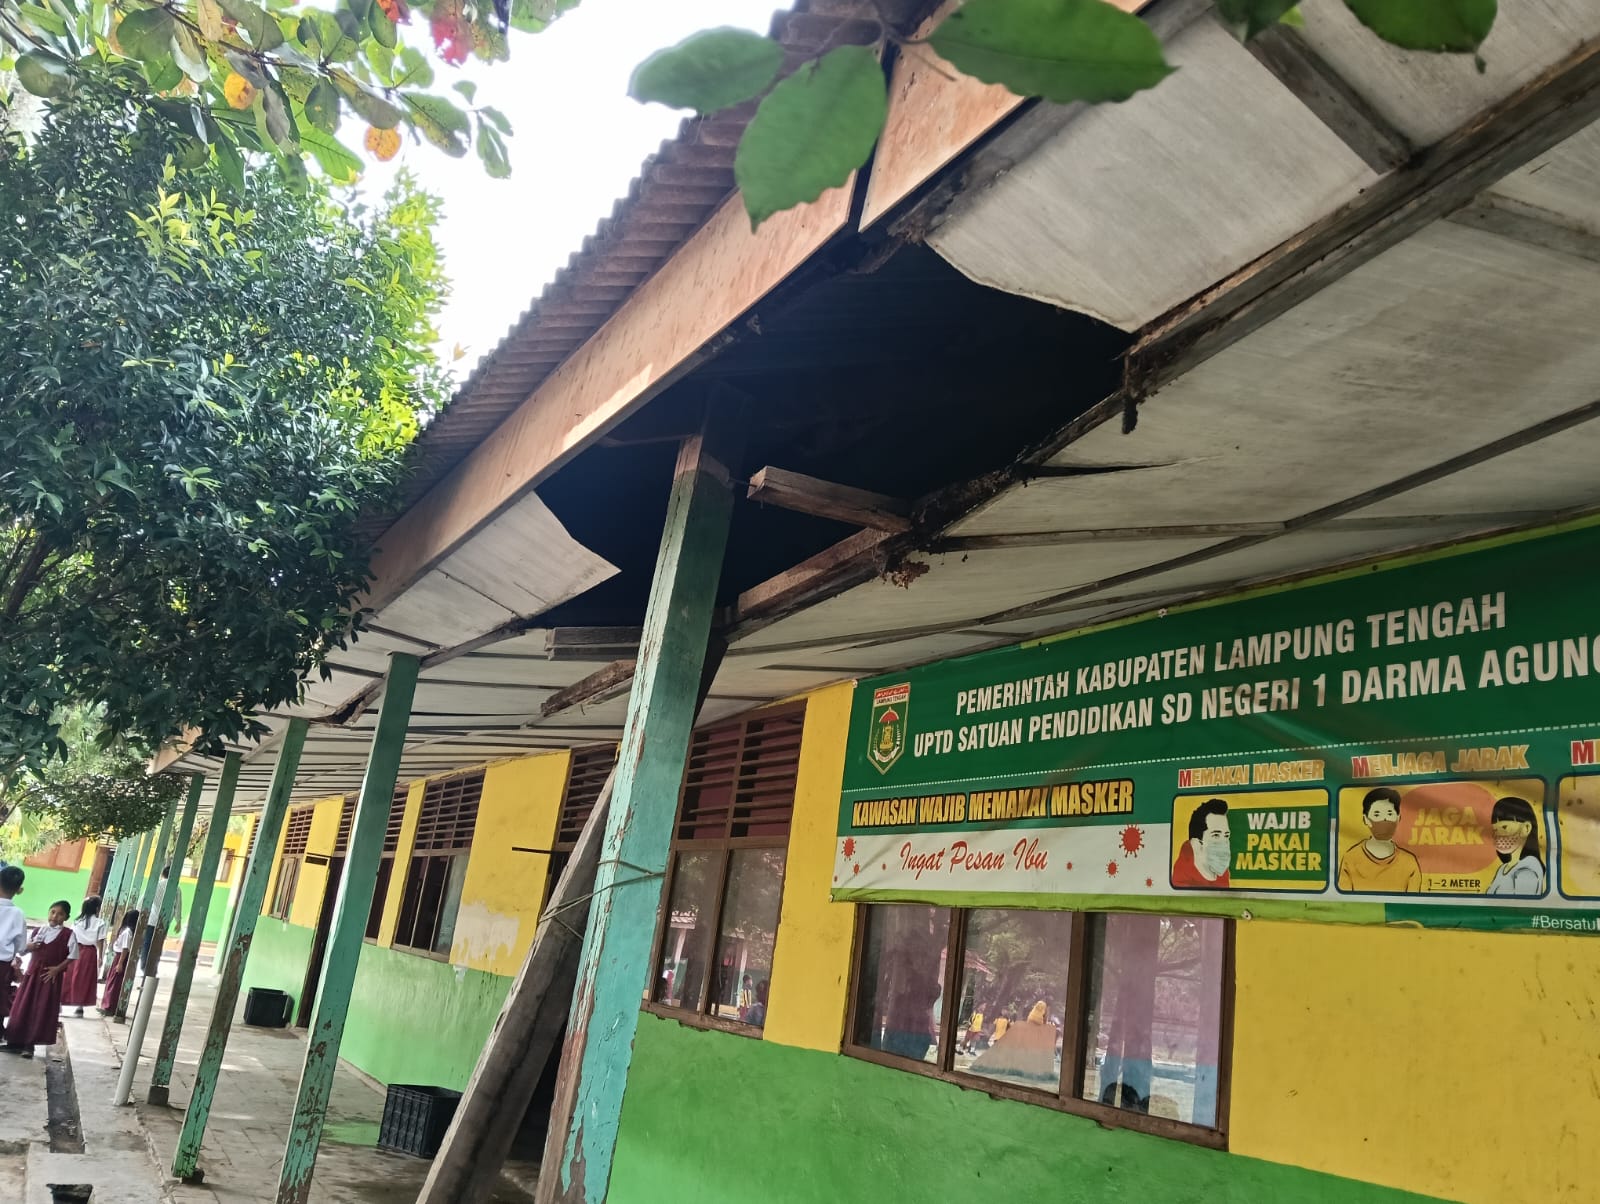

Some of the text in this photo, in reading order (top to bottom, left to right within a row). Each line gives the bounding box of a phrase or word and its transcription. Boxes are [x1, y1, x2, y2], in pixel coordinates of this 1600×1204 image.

[956, 592, 1506, 715] PEMERINTAH KABUPATEN LAMPUNG TENGAH
[914, 729, 954, 757] UPTD
[958, 718, 1023, 752] SATUAN
[1028, 697, 1153, 742] PENDIDIKAN
[1161, 692, 1192, 724] SD
[1201, 677, 1300, 720] NEGERI
[1312, 673, 1327, 707] 1
[1342, 655, 1466, 705] DARMA
[1351, 744, 1530, 778] MENJAGA JARAK
[1178, 760, 1325, 788] MEMAKAI MASKER
[852, 781, 1133, 827] KAWASAN WAJIB MEMAKAI MASKER
[1414, 806, 1477, 826] JAGA
[1247, 811, 1311, 830] WAJIB
[1247, 833, 1310, 850] PAKAI
[1408, 826, 1484, 845] JARAK
[900, 838, 1049, 880] Ingat Pesan Ibu
[1235, 852, 1322, 871] MASKER
[1450, 879, 1481, 888] METER
